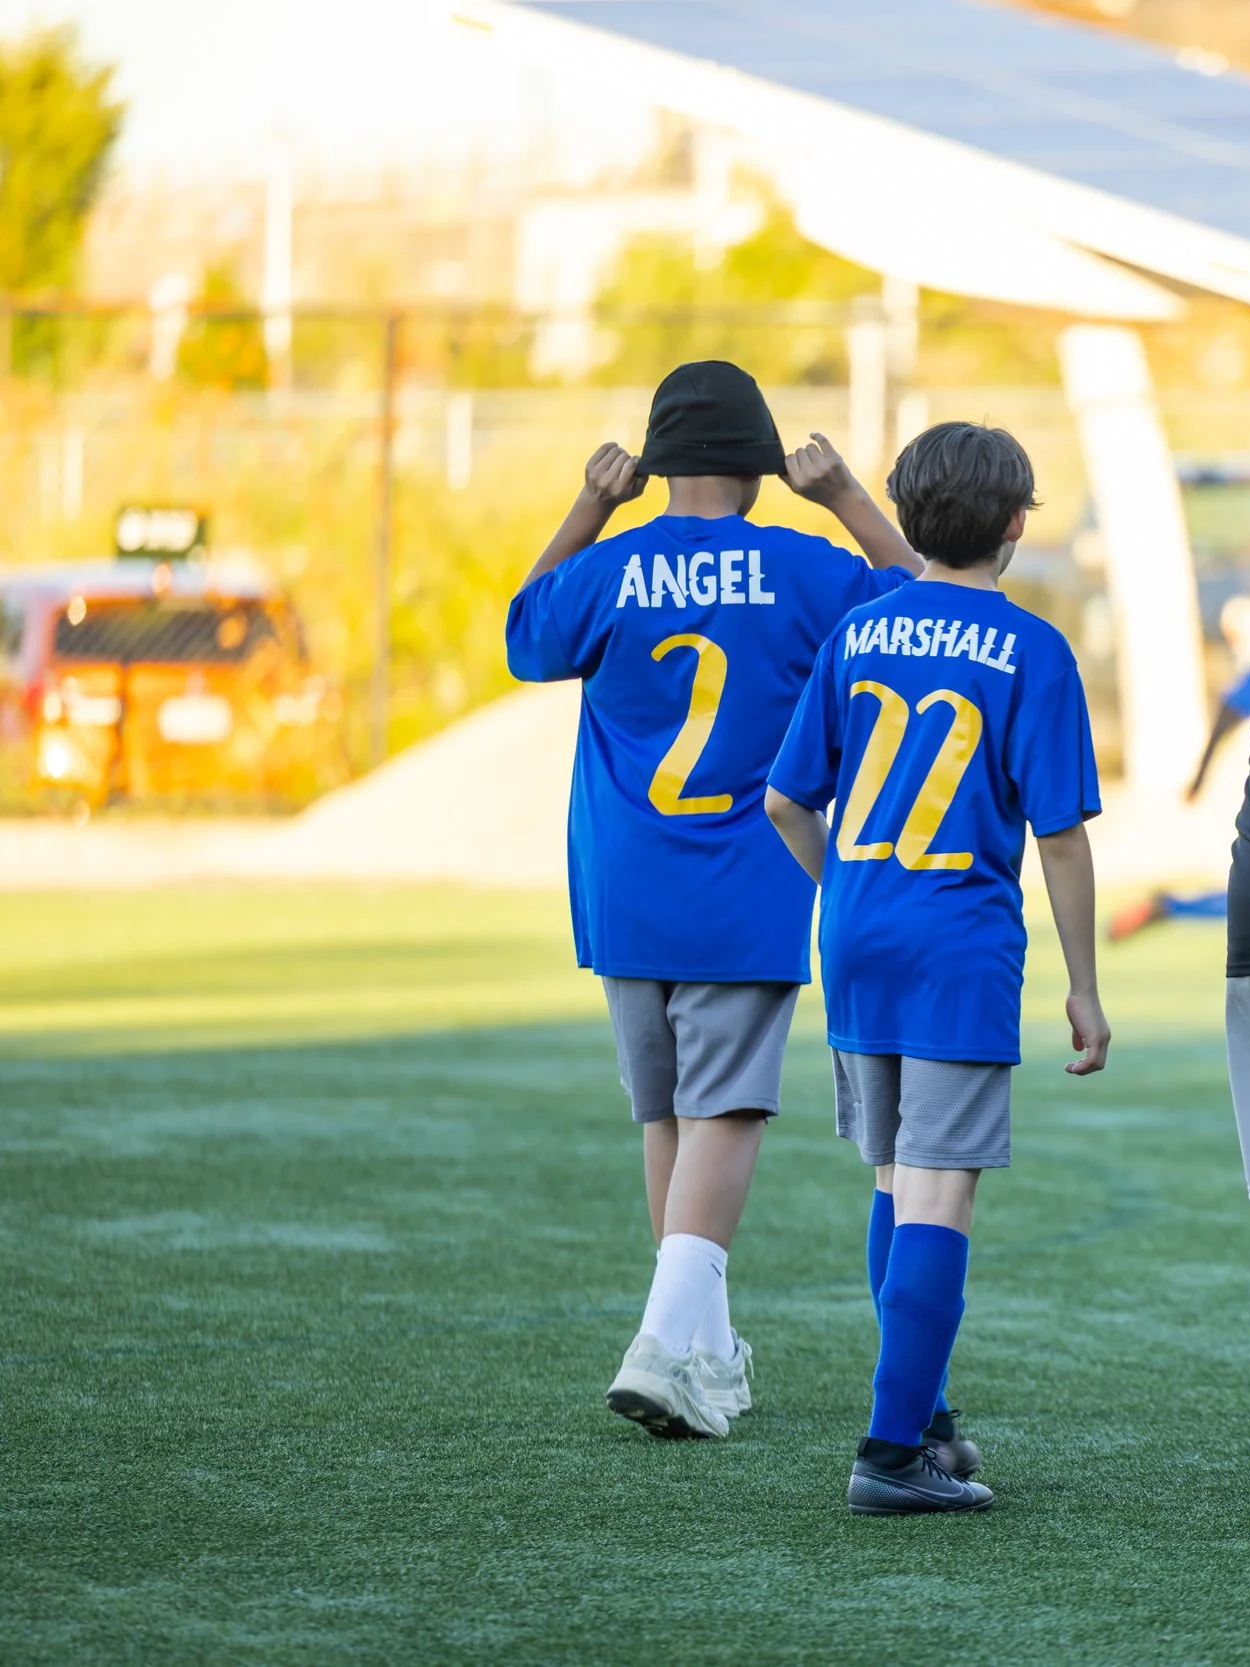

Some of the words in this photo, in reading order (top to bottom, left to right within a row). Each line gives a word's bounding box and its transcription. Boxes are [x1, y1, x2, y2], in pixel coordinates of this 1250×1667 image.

[616, 550, 775, 608] ANGEL
[844, 616, 1017, 674] MARSHALL
[648, 633, 733, 816] 2
[836, 680, 983, 871] 22
